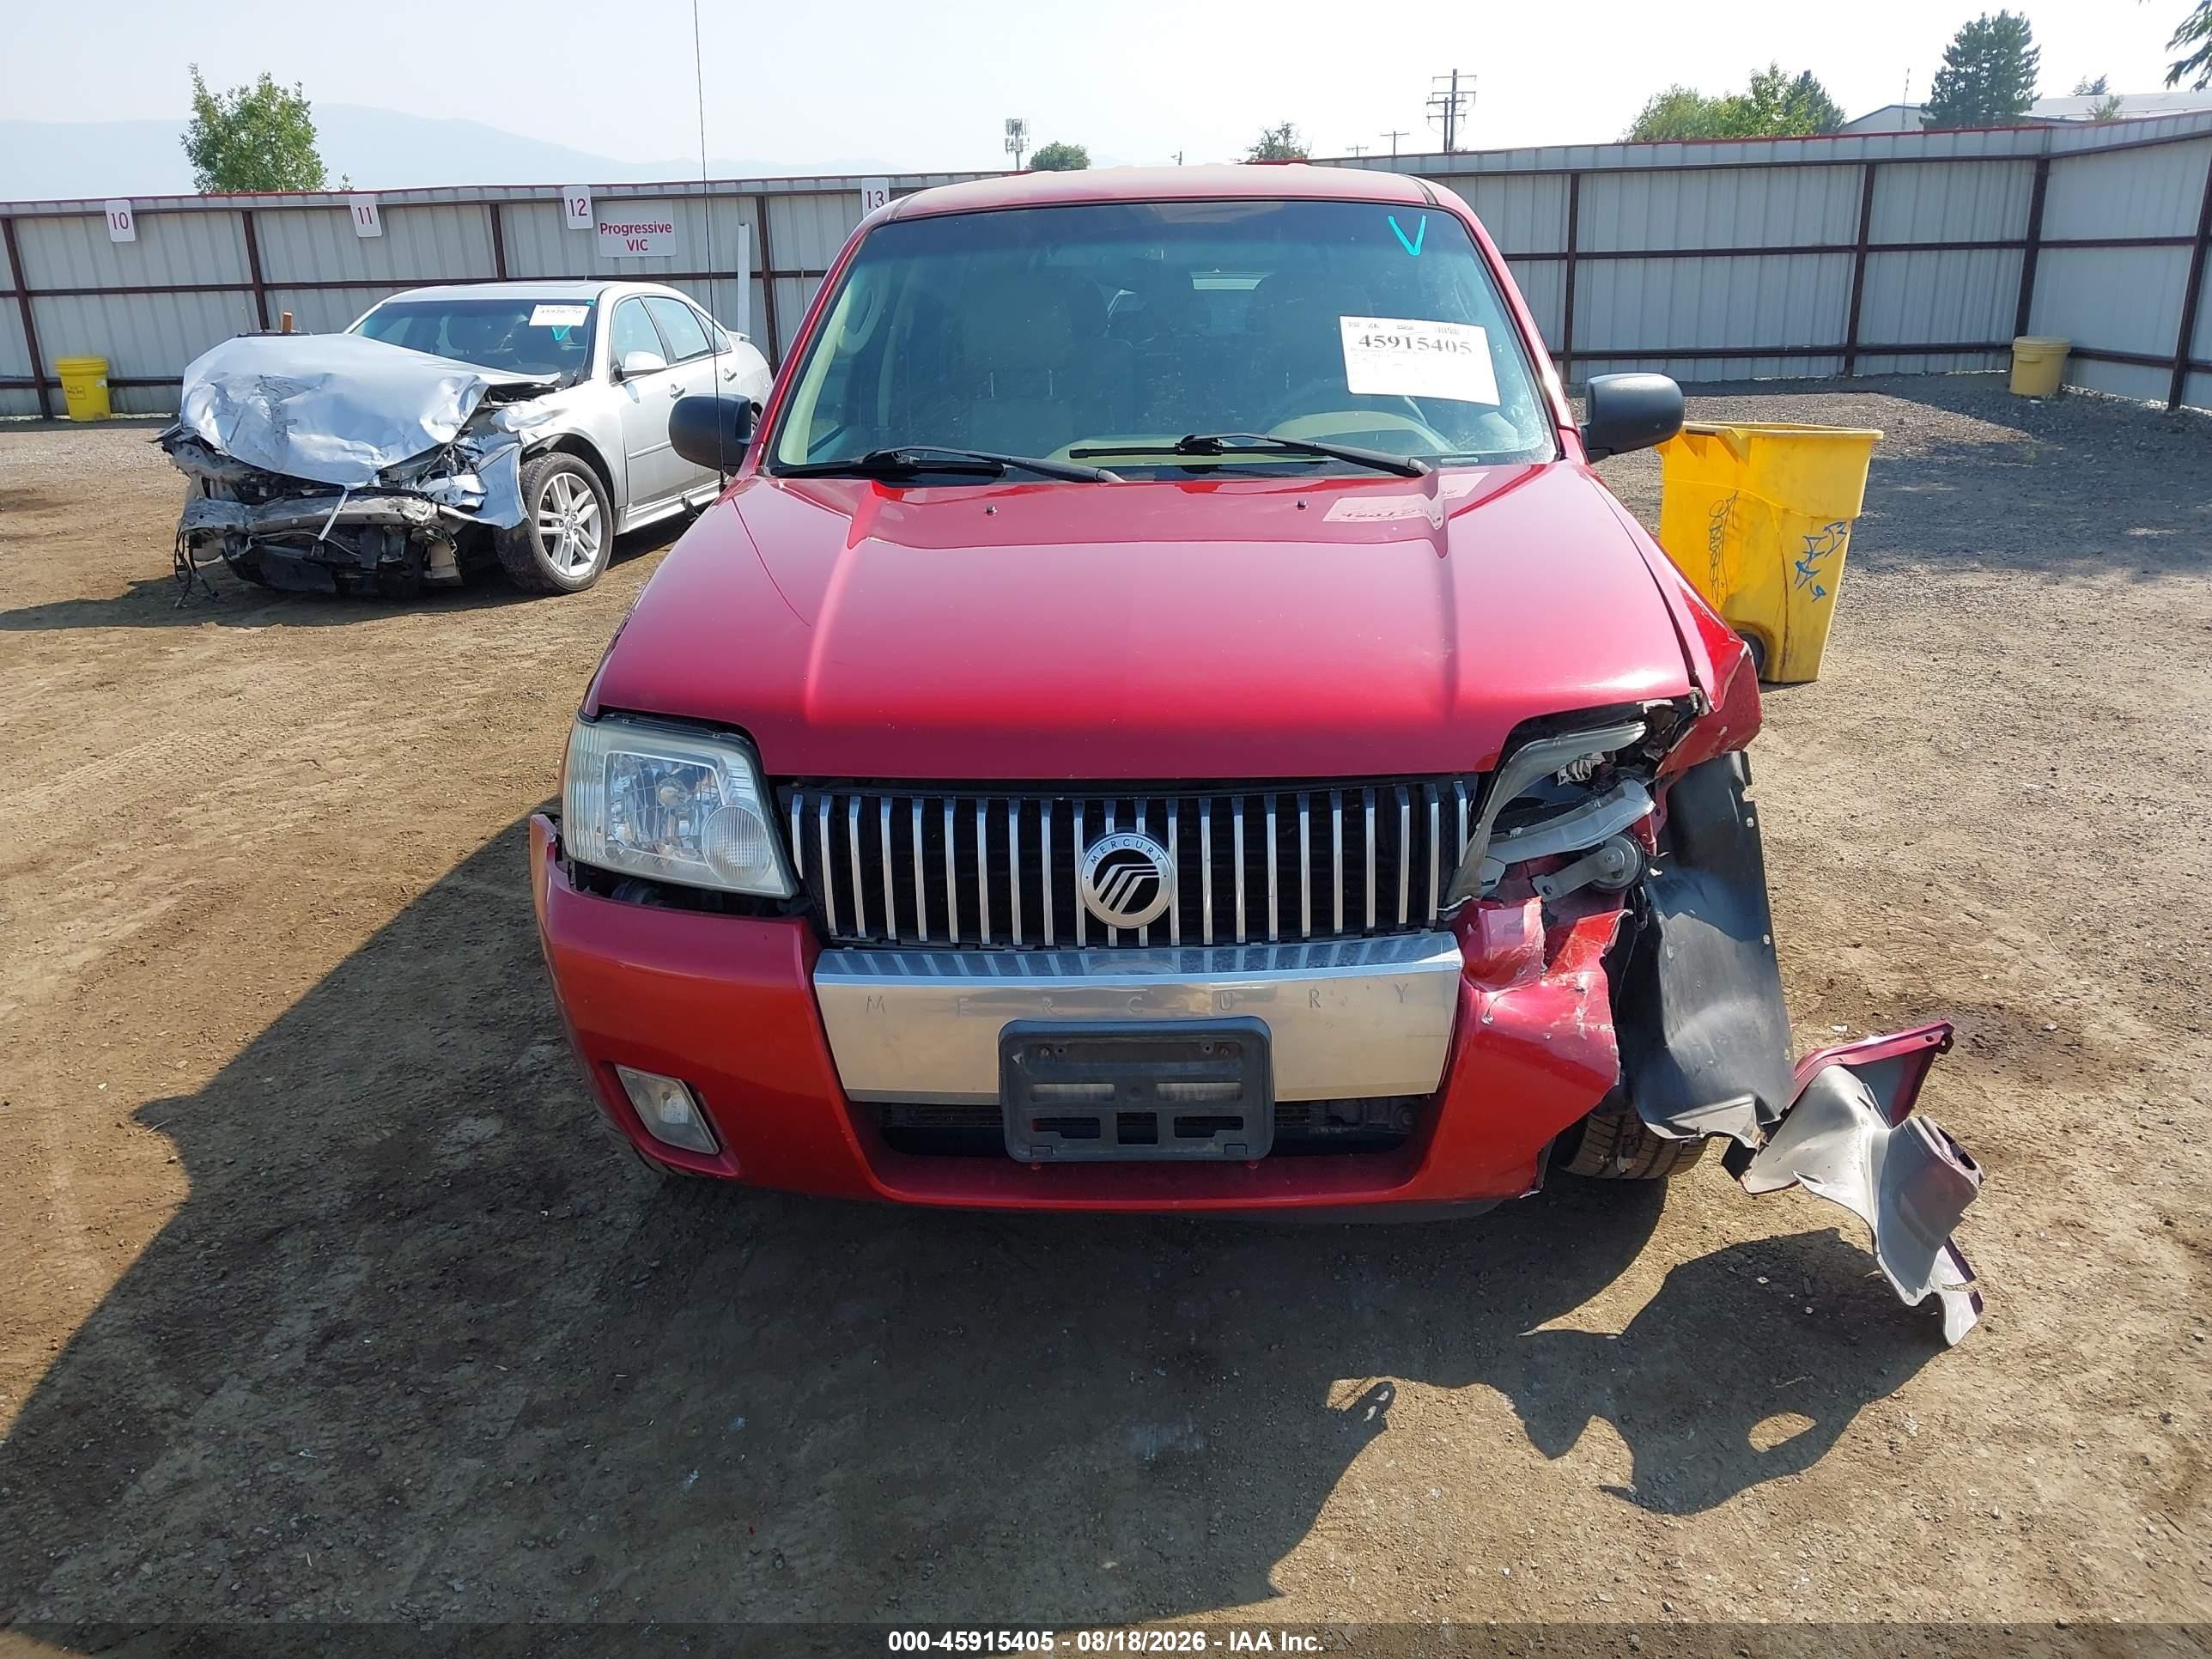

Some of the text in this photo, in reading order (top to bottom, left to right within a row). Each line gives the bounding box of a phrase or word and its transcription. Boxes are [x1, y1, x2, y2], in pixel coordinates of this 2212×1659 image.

[568, 198, 587, 216] 12
[866, 191, 884, 209] 13
[111, 212, 129, 230] 10
[357, 206, 373, 224] 11
[599, 221, 672, 236] Progressive
[626, 239, 649, 252] VIC
[1358, 334, 1473, 356] 45915405
[1090, 838, 1163, 866] MERCURY
[866, 981, 1409, 1017] MERCURY
